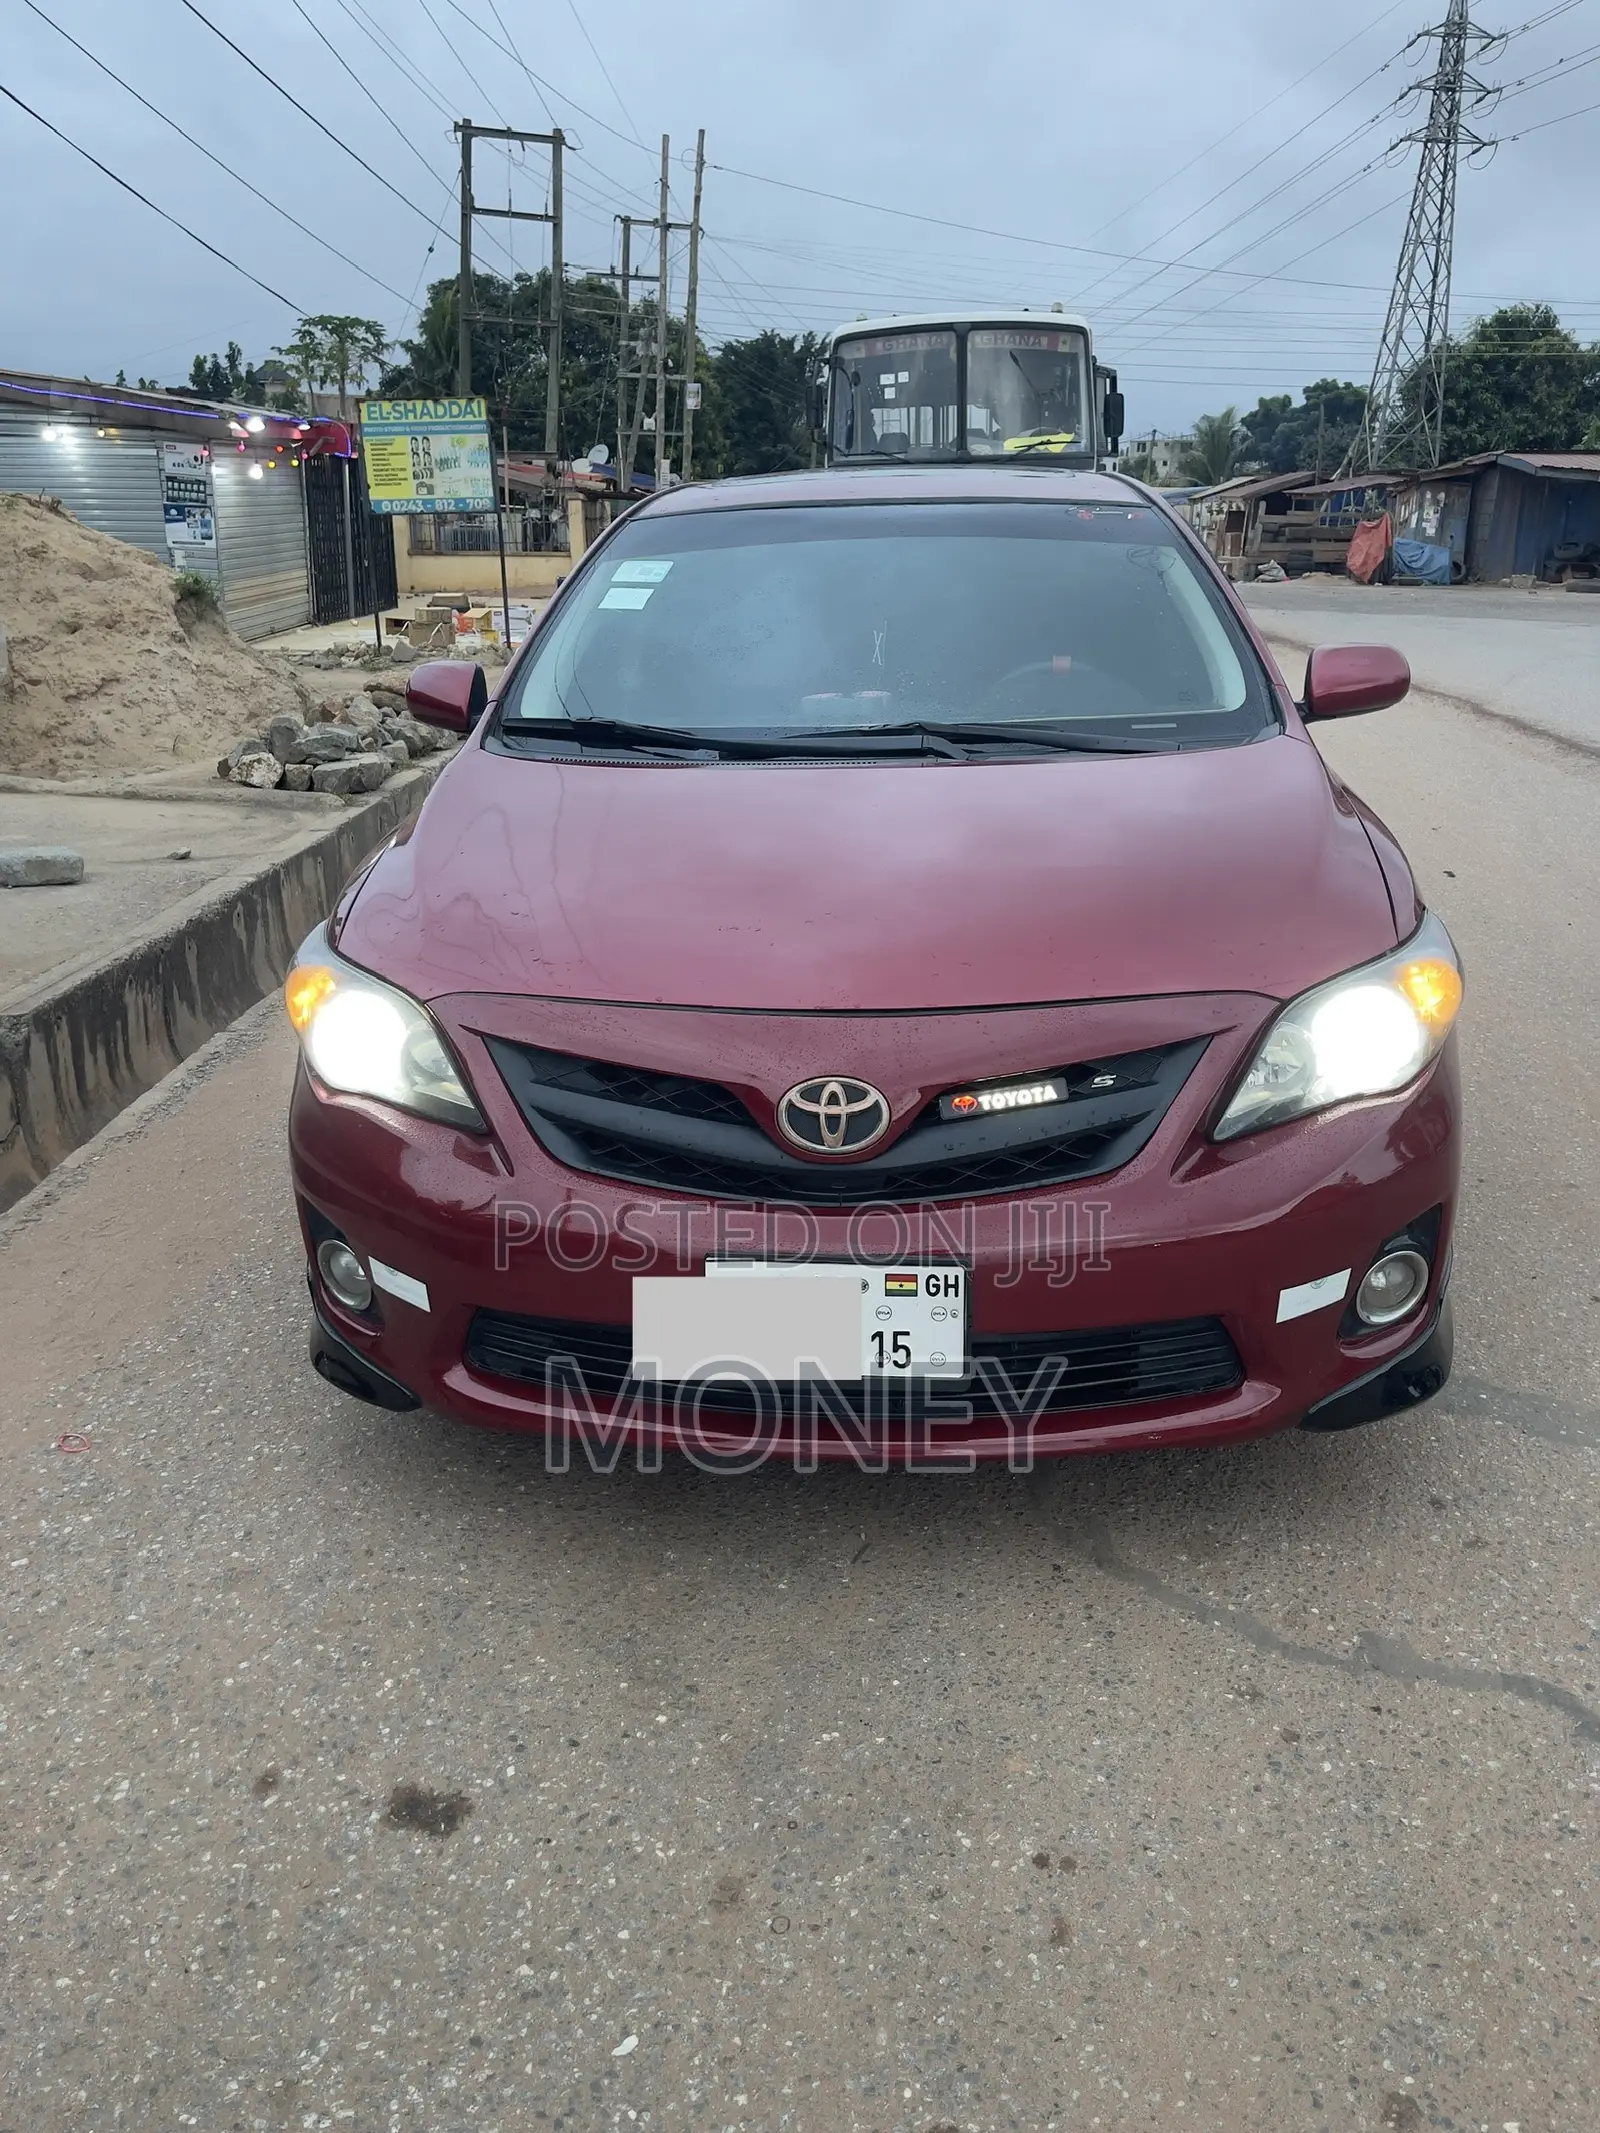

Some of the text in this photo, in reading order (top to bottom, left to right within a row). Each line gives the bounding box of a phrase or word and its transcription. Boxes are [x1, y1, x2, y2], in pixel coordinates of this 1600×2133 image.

[981, 333, 1043, 347] GHANA
[367, 400, 482, 421] EL-SHADDAI
[978, 1085, 1058, 1111] TOYOTA
[925, 1273, 959, 1298] GH
[870, 1331, 912, 1369] 15
